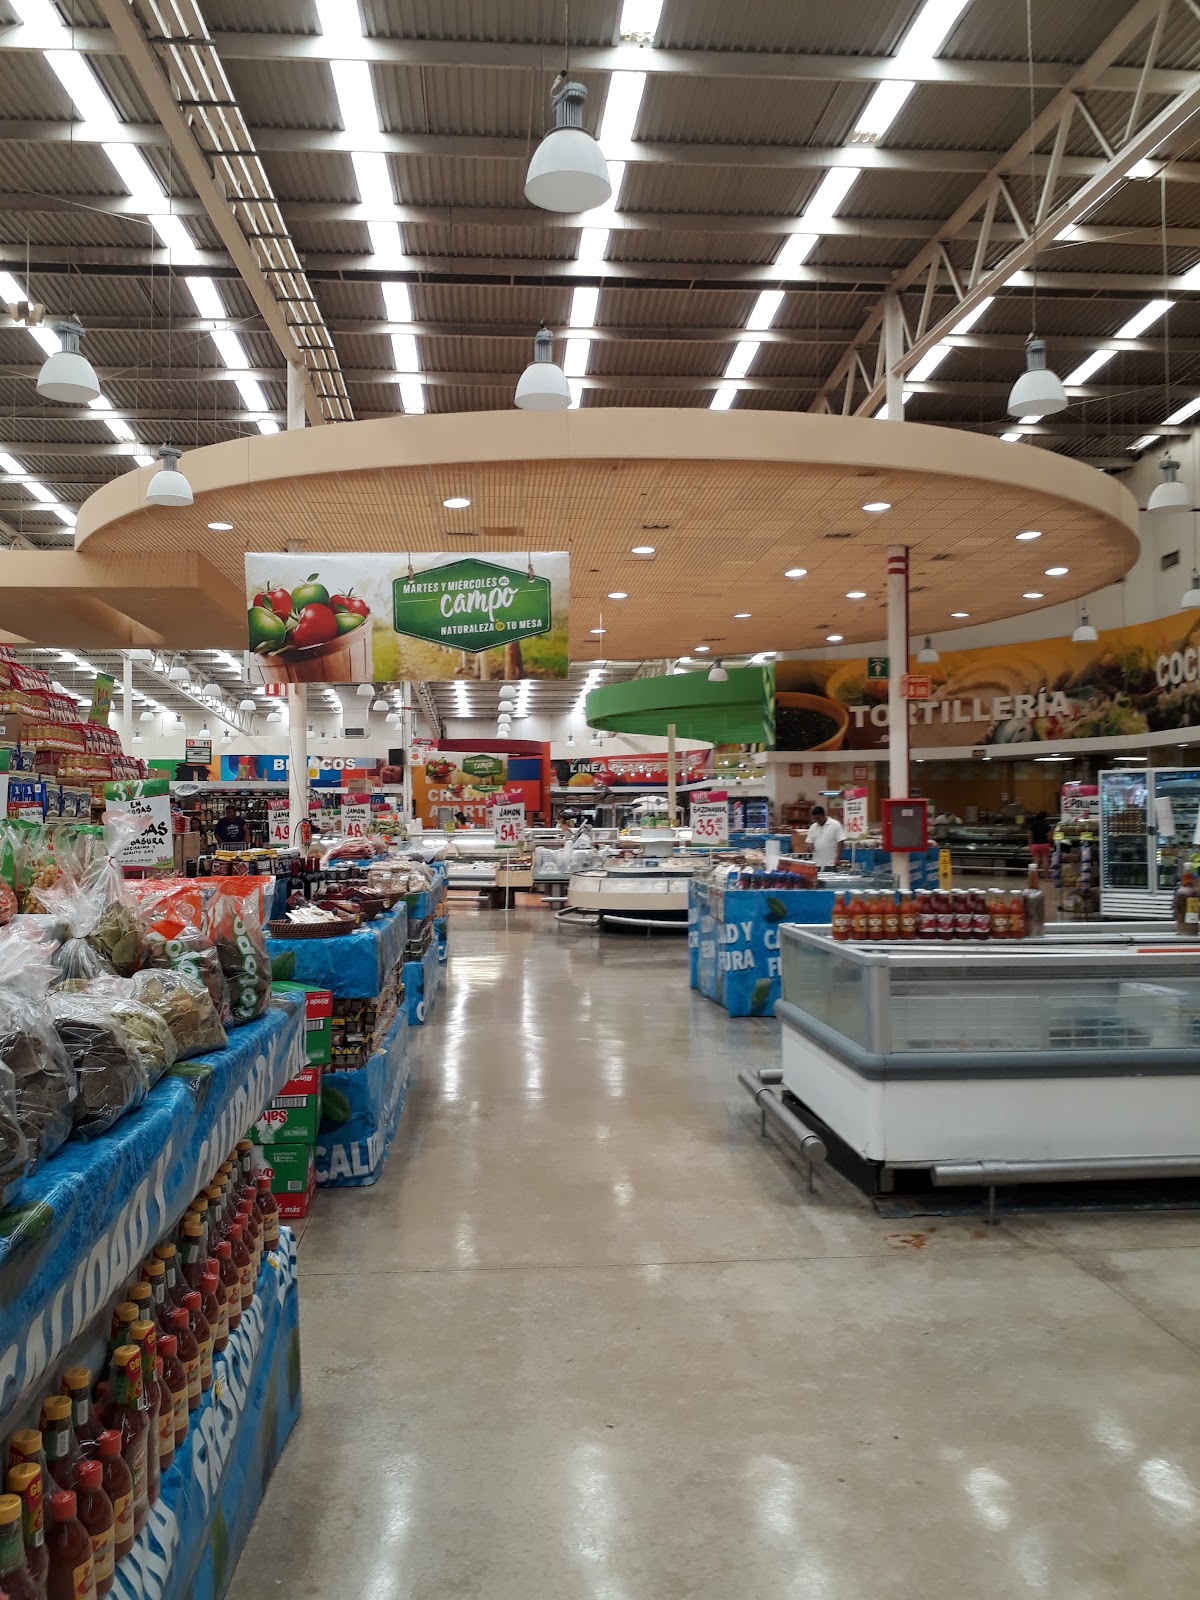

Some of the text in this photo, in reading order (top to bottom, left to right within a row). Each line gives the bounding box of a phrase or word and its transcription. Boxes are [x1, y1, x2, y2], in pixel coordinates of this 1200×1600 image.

[403, 582, 439, 594] MARTES
[440, 581, 448, 592] Y
[447, 576, 498, 591] MIÉRCOLES
[440, 586, 520, 622] campo
[440, 622, 495, 636] NATURALEZA
[506, 621, 518, 631] TU
[519, 619, 543, 629] MESA
[1156, 646, 1200, 687] COC
[273, 758, 356, 771] BNCOS
[130, 801, 142, 809] EN
[499, 808, 521, 817] JAMON
[500, 823, 515, 842] 54
[284, 1205, 301, 1213] más
